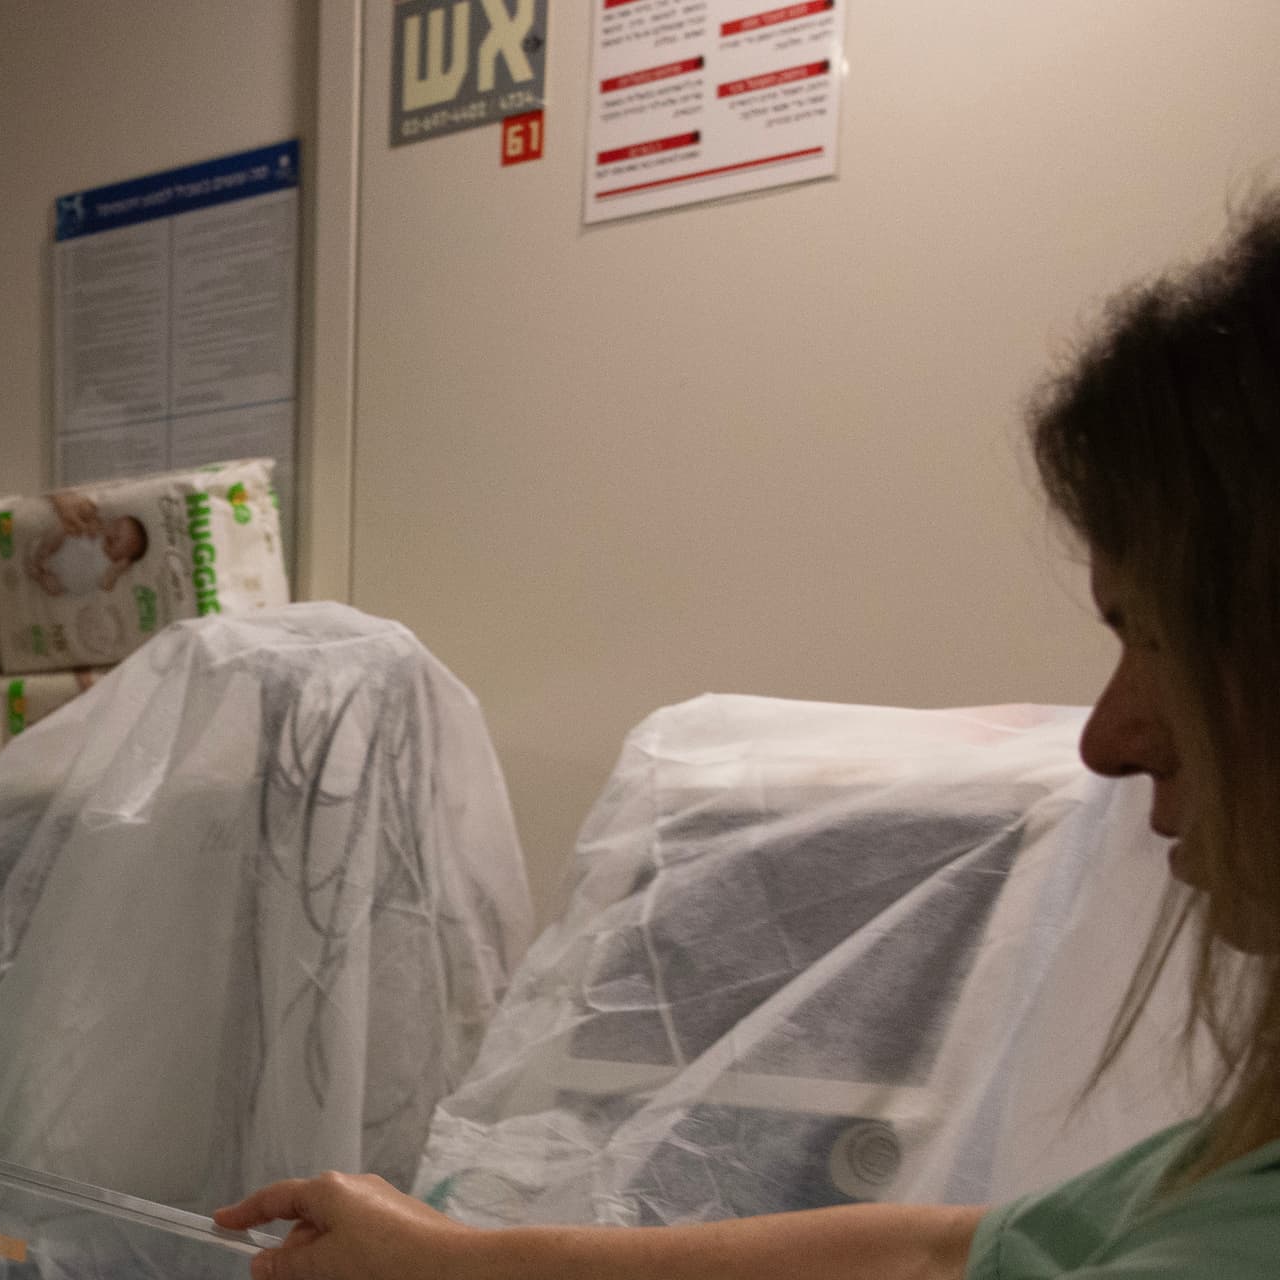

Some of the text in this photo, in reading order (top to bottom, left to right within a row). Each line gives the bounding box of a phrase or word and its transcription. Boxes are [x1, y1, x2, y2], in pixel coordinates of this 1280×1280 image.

[402, 0, 536, 112] אש
[505, 120, 541, 158] 61
[186, 492, 224, 617] HUGGIE
